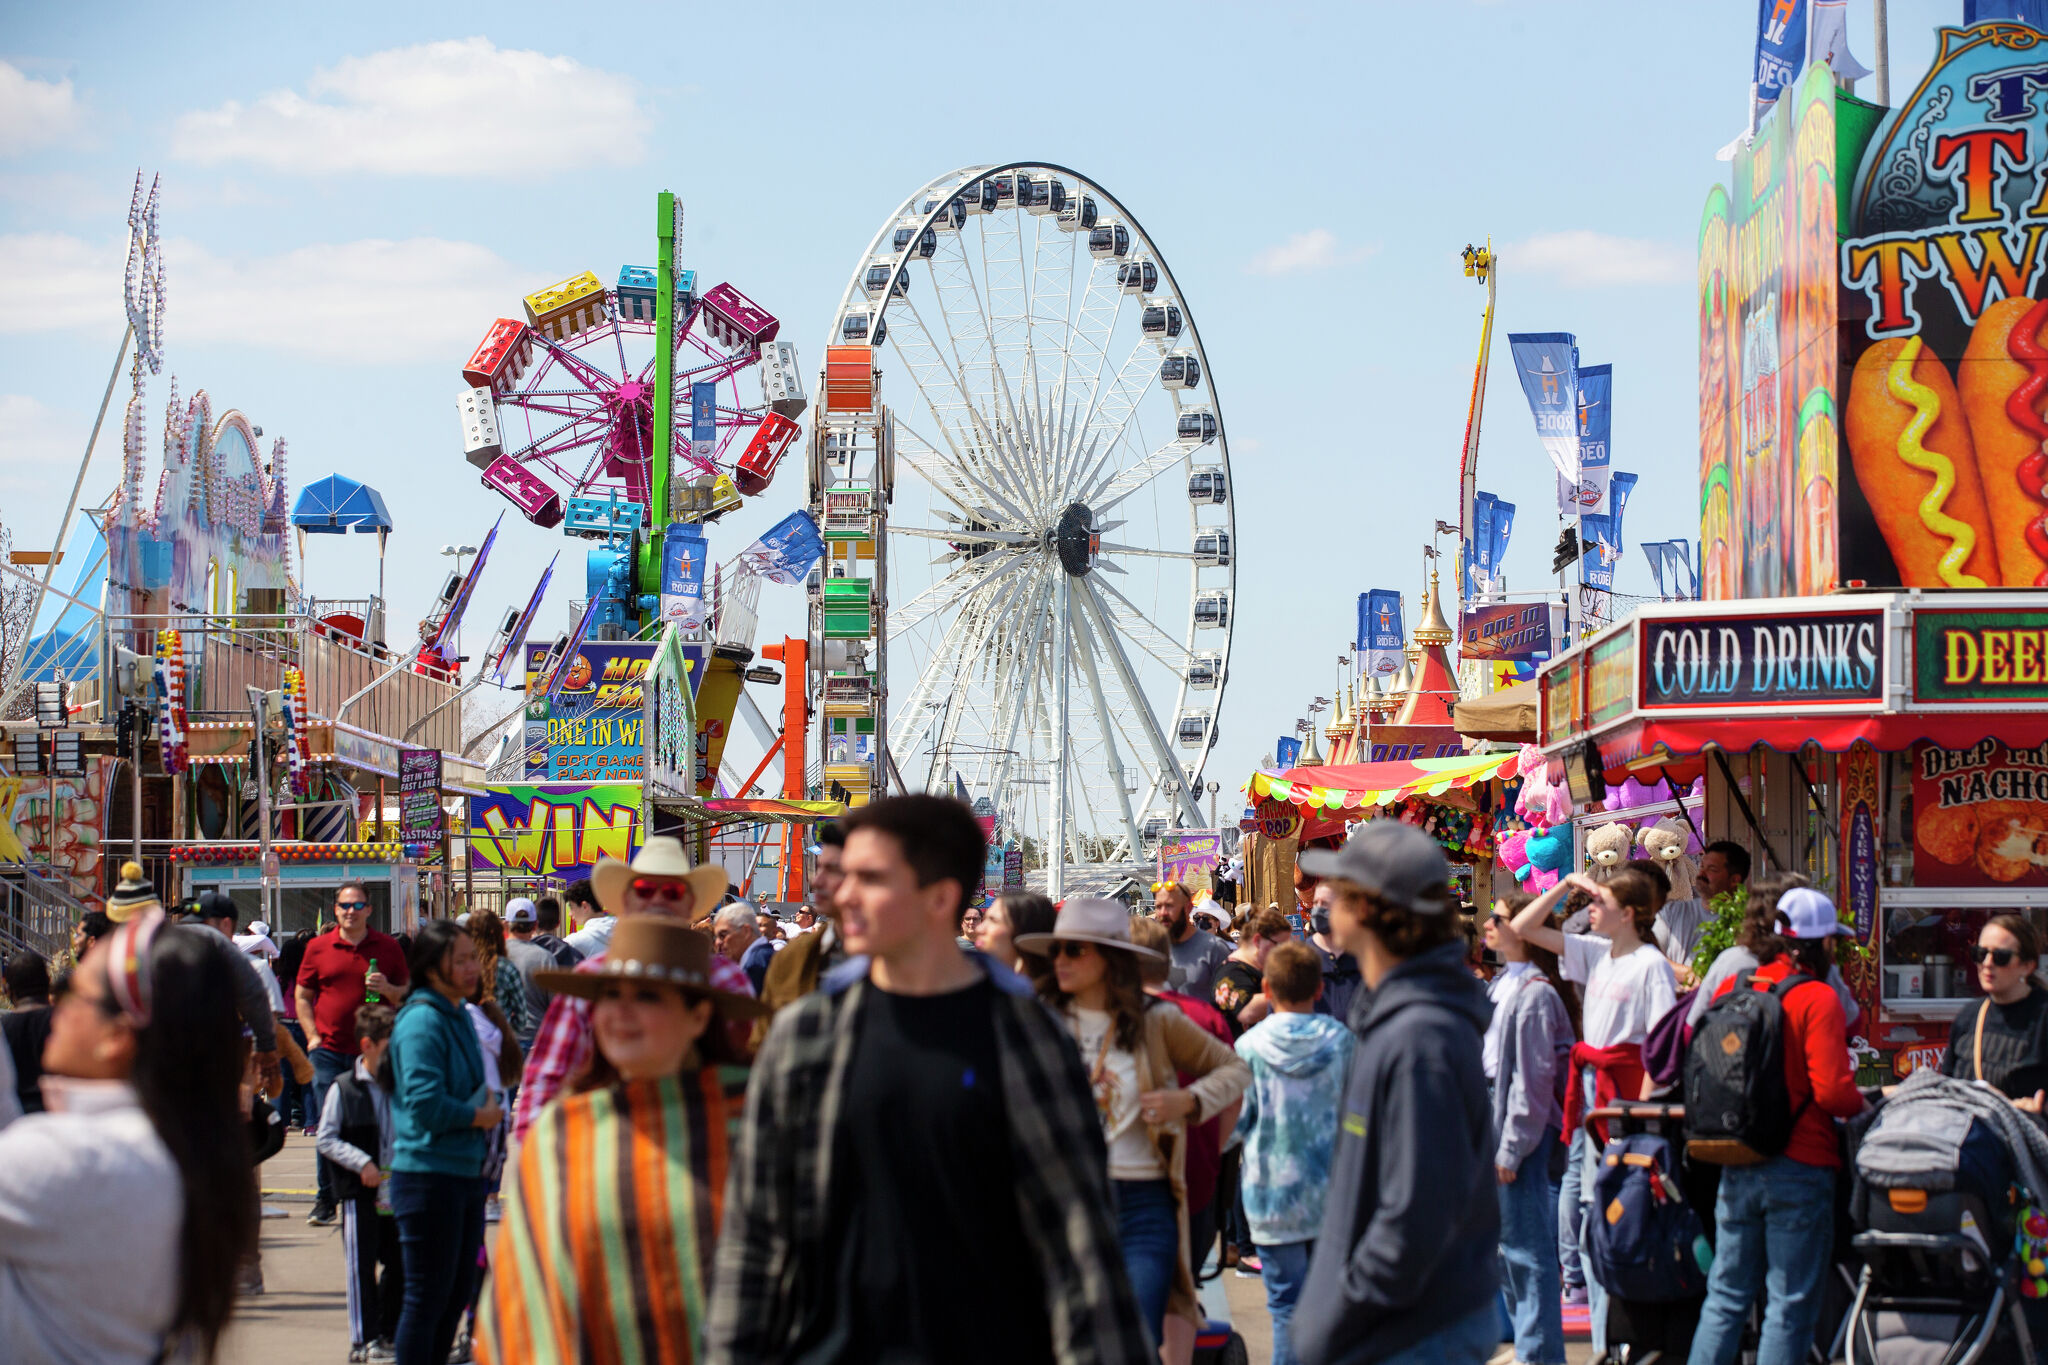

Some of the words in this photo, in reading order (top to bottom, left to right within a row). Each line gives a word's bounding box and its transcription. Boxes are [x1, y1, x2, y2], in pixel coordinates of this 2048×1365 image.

[671, 583, 699, 595] RODEO
[1483, 614, 1515, 638] ONE
[1499, 623, 1546, 651] WINS
[1653, 627, 1743, 696] COLD
[1752, 621, 1879, 692] DRINKS
[1943, 629, 2048, 684] DEE
[547, 718, 587, 747] ONE
[592, 718, 613, 747] IN
[556, 755, 594, 767] GOT
[402, 773, 415, 783] GET
[415, 772, 423, 781] IN
[423, 770, 435, 779] THE
[557, 769, 601, 781] PLAY
[400, 782, 417, 792] FAST
[403, 793, 436, 810] FAST
[1258, 799, 1297, 819] BALLOON
[405, 806, 439, 823] PASS
[400, 829, 443, 841] FASTPASS
[481, 797, 635, 874] WIN
[1265, 818, 1291, 837] POP
[1856, 814, 1869, 858] TATER
[1164, 844, 1187, 856] Dole
[1187, 838, 1216, 854] WHIP
